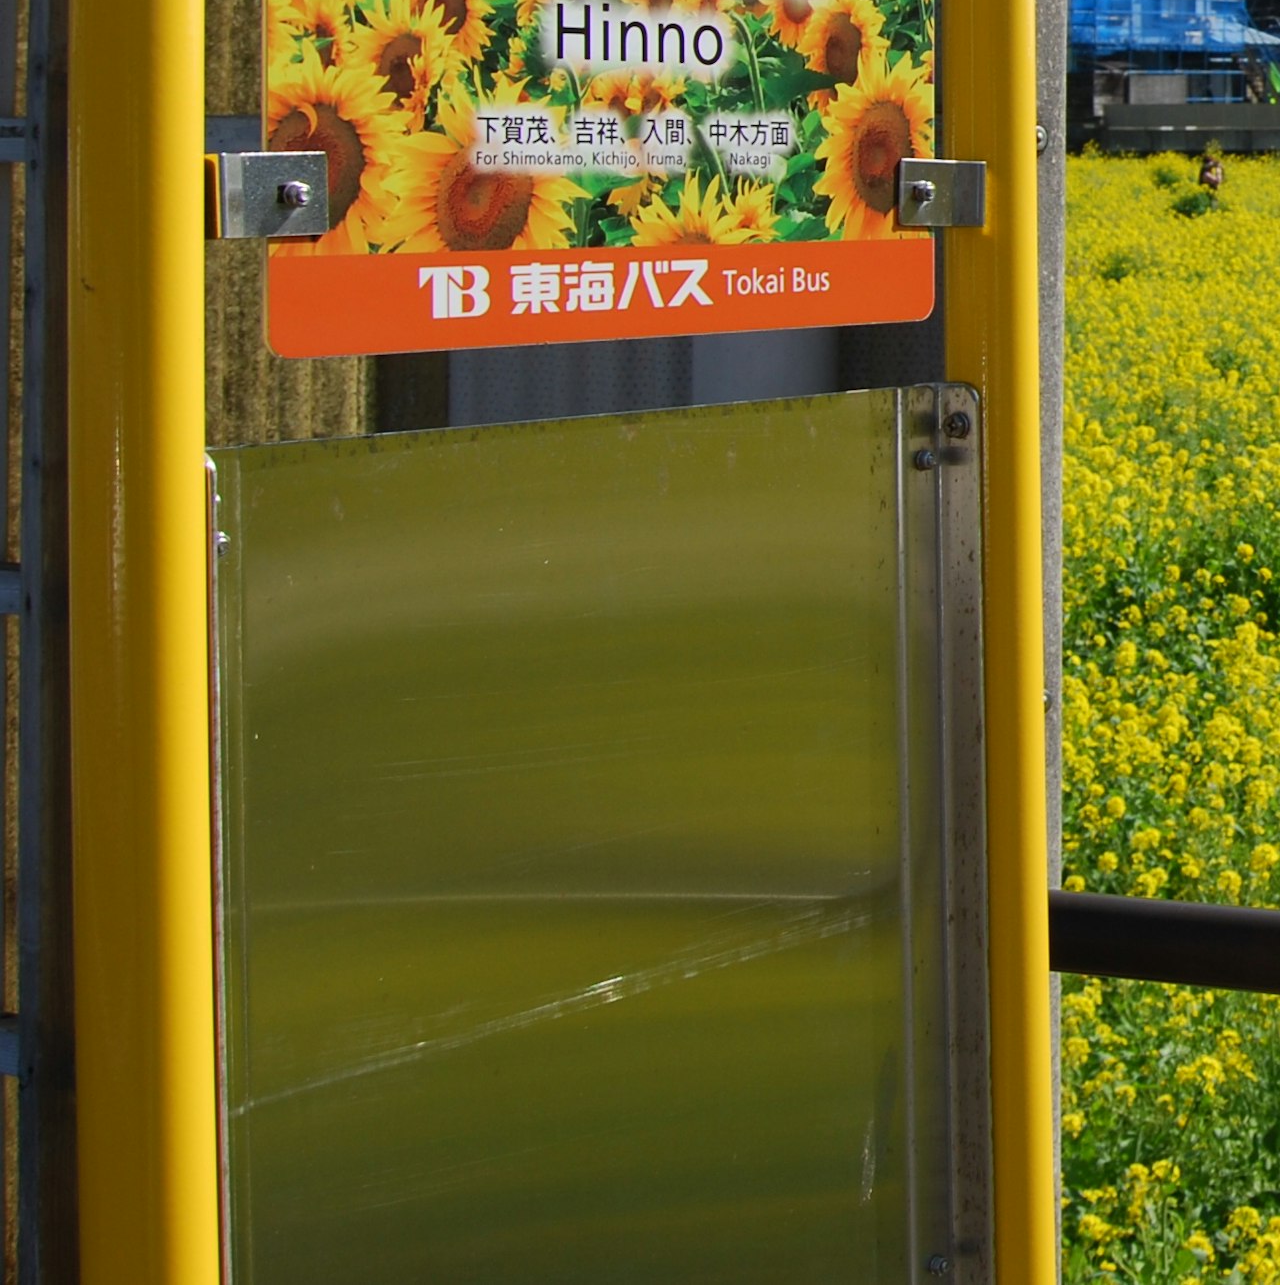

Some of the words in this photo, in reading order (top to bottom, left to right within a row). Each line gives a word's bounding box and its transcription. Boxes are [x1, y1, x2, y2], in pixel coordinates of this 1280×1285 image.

[555, 3, 724, 66] Hinno
[476, 151, 498, 166] For
[503, 151, 588, 168] Shimokamo,
[592, 151, 640, 169] Kichijo,
[646, 152, 687, 167] Iruma,
[729, 154, 772, 169] Nakagi
[510, 259, 714, 315] 東海バス
[723, 267, 785, 295] Tokai
[792, 268, 831, 293] Bus
